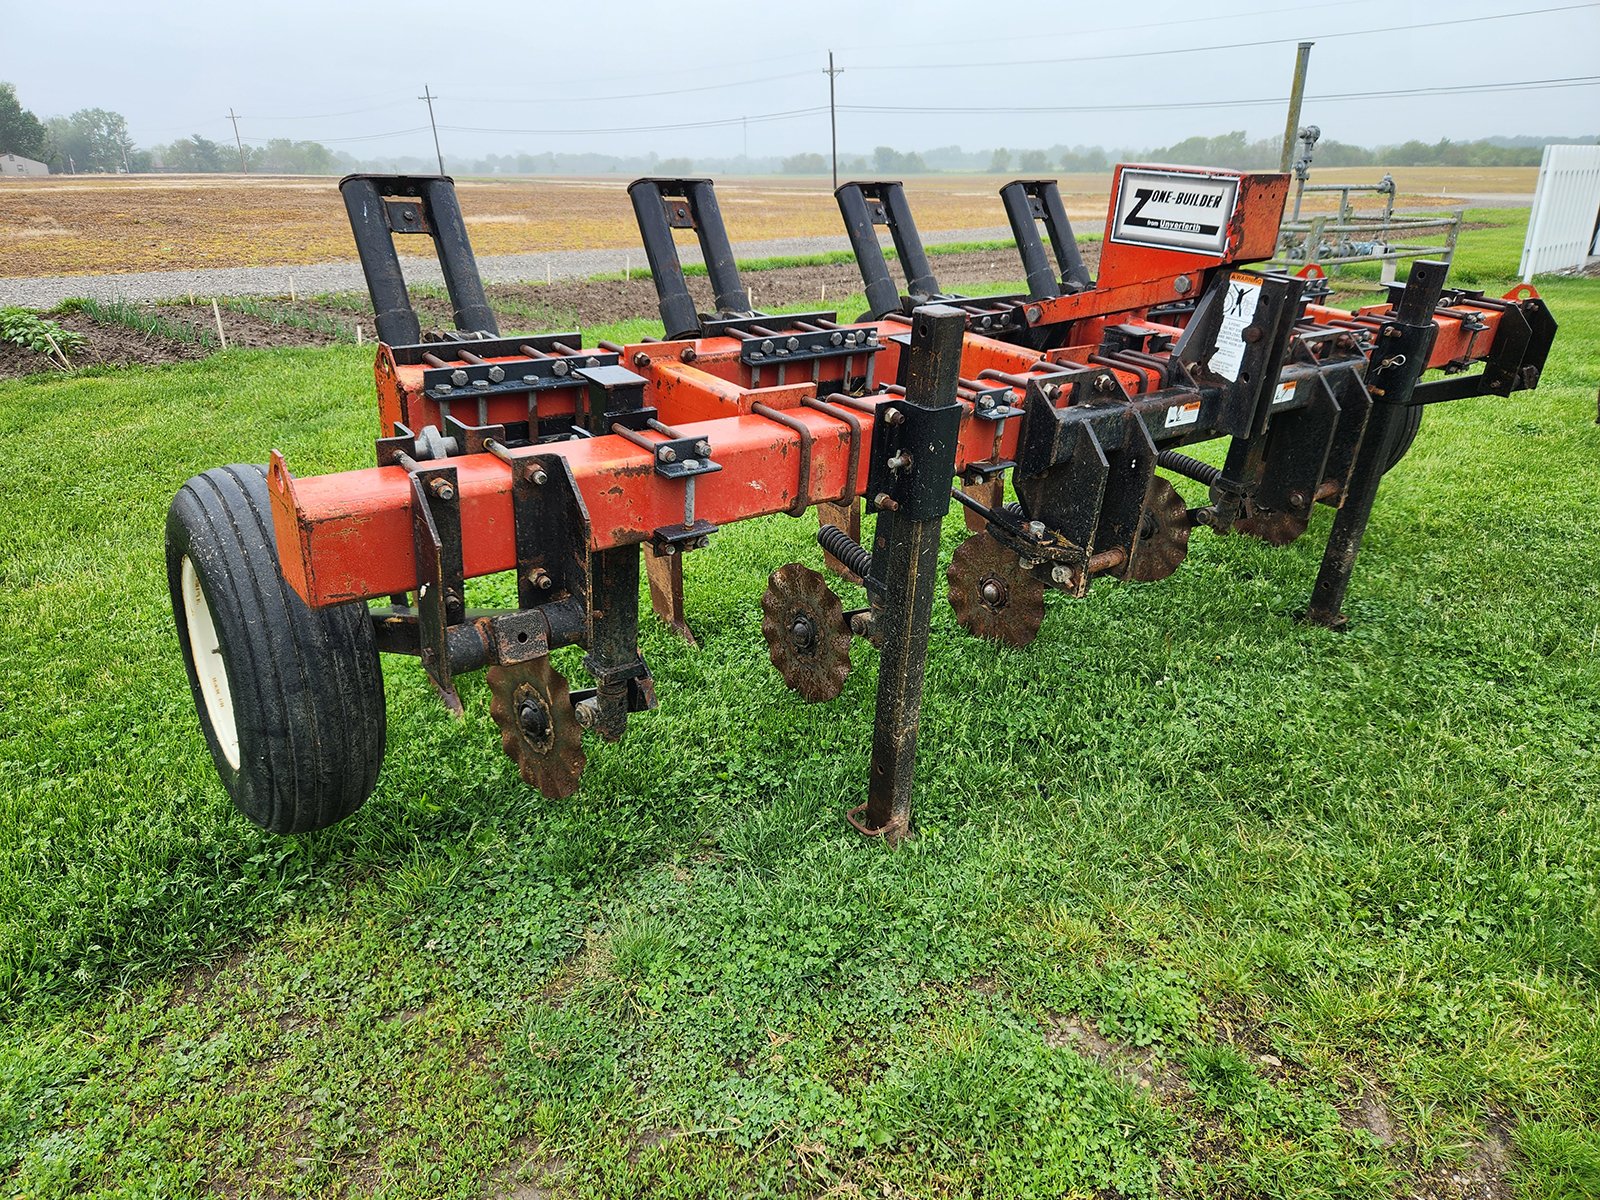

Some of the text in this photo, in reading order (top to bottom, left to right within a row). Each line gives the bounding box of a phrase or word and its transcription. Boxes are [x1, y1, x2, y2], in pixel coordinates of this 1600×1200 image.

[1124, 188, 1222, 225] ZONE-BUILDER
[1147, 219, 1159, 227] from
[1236, 273, 1263, 285] WARNING
